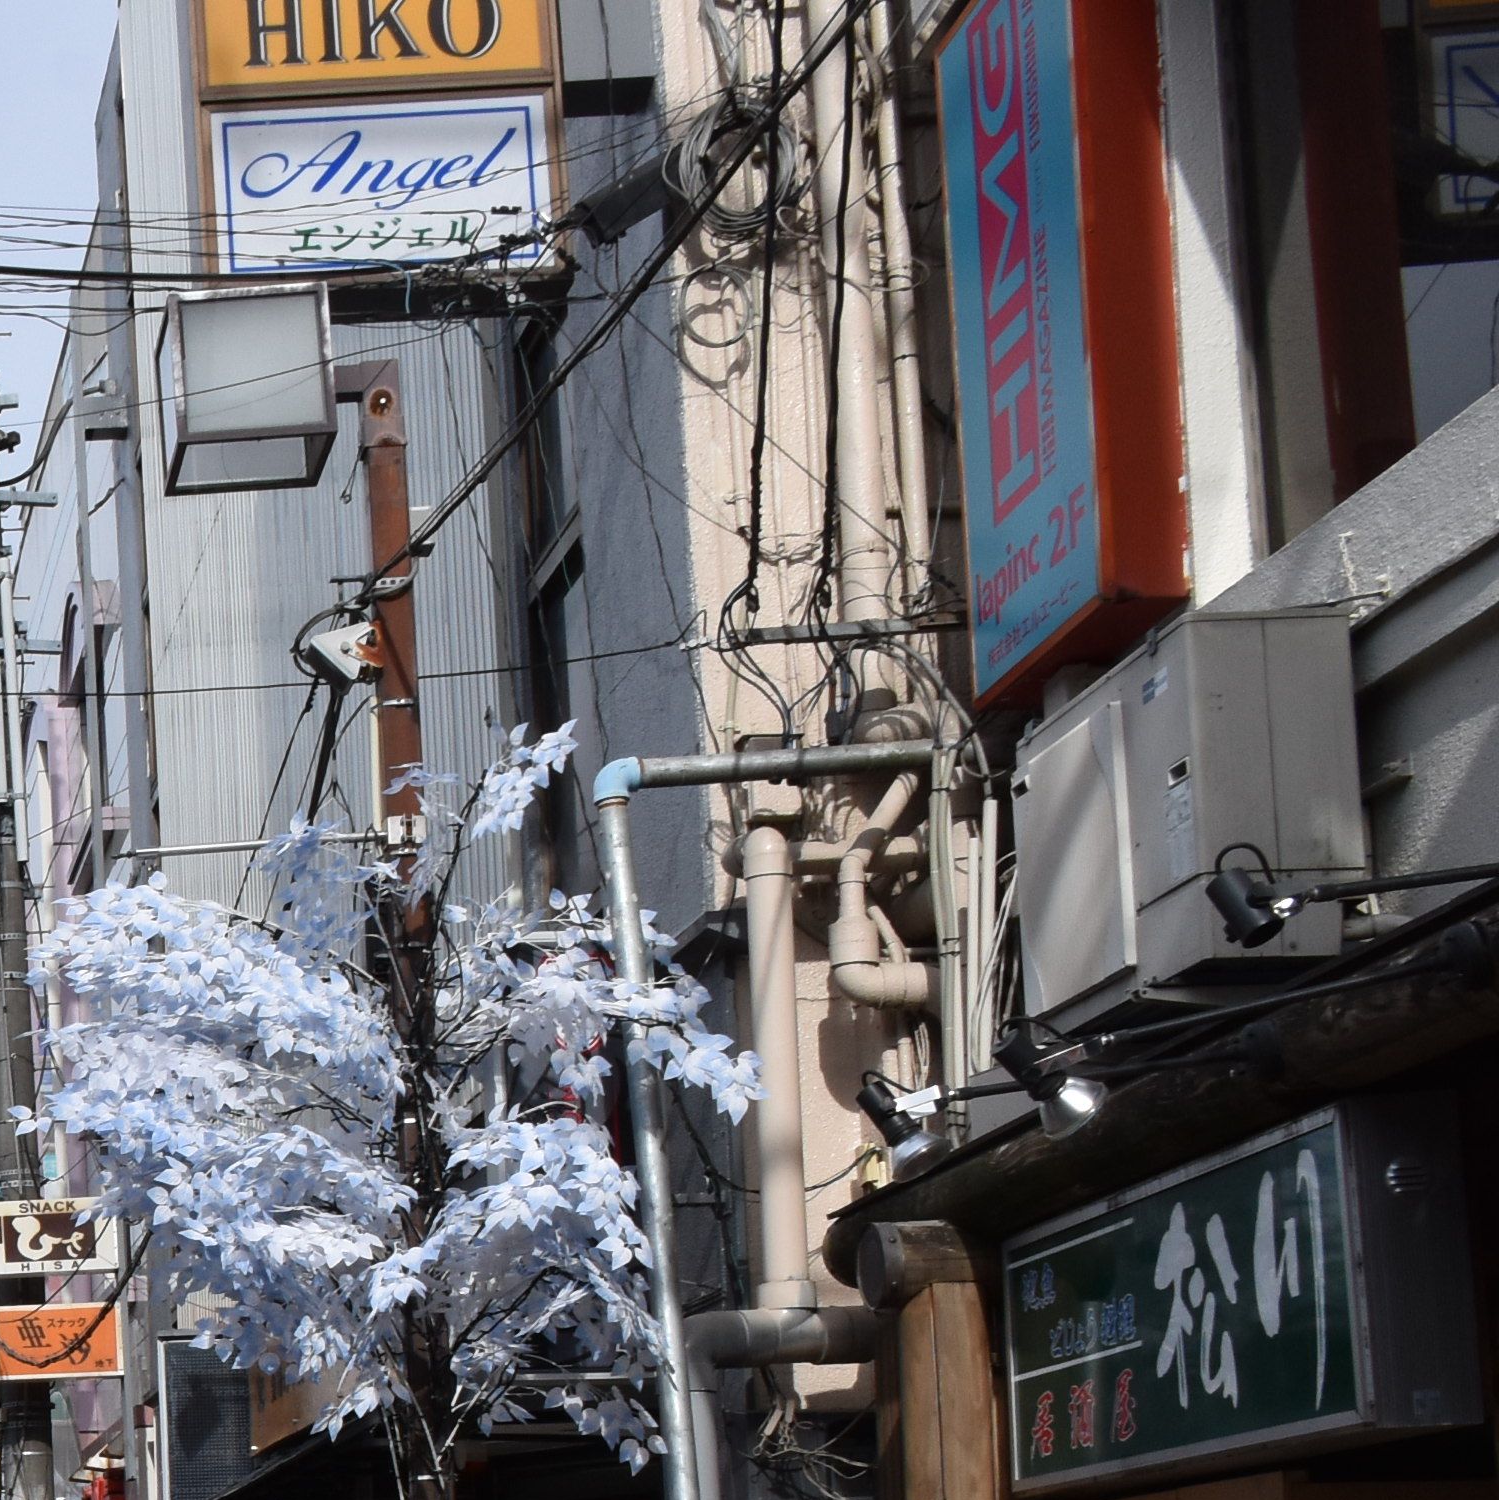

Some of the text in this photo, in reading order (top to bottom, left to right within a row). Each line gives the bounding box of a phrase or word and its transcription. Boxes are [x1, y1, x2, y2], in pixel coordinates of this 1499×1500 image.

[240, 127, 517, 211] Angel
[289, 215, 480, 253] エンジェル
[976, 483, 1087, 626] lapinc 2F
[18, 1200, 77, 1213] SNACK
[47, 1316, 87, 1328] スナック
[1031, 1369, 1137, 1460] 居酒屋
